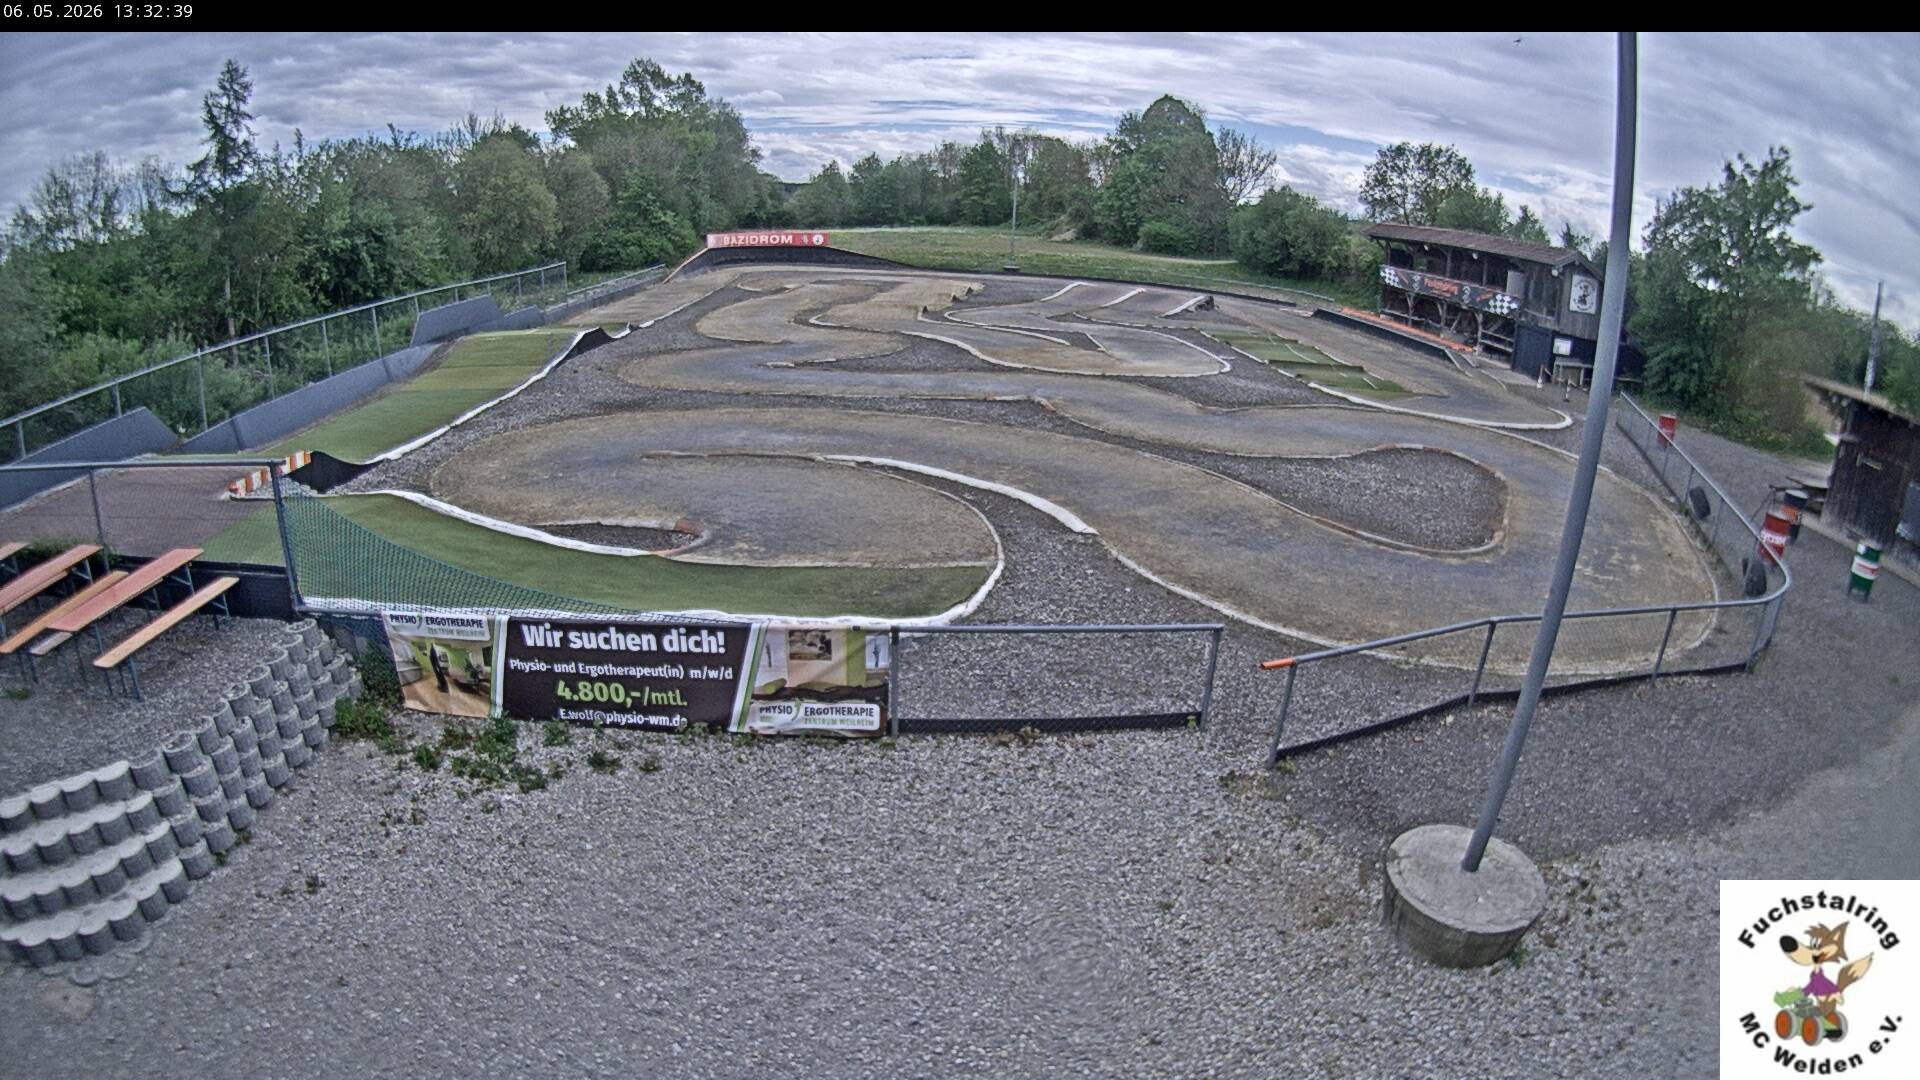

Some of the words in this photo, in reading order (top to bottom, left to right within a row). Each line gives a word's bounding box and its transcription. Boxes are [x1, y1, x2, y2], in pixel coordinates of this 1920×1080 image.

[723, 234, 793, 246] BAZIDROM
[389, 613, 417, 625] PHYSIO
[424, 616, 485, 628] ERGOTHERAPIE
[521, 623, 563, 647] Wir
[568, 627, 657, 651] suchen
[662, 627, 726, 654] dich!
[509, 657, 552, 672] Physio-
[553, 662, 577, 674] und
[578, 663, 684, 679] Ergotherapeut(in)
[689, 666, 733, 680] m/w/d
[759, 705, 793, 715] PHYSIO
[804, 706, 875, 717] ERGOTHERAPIE
